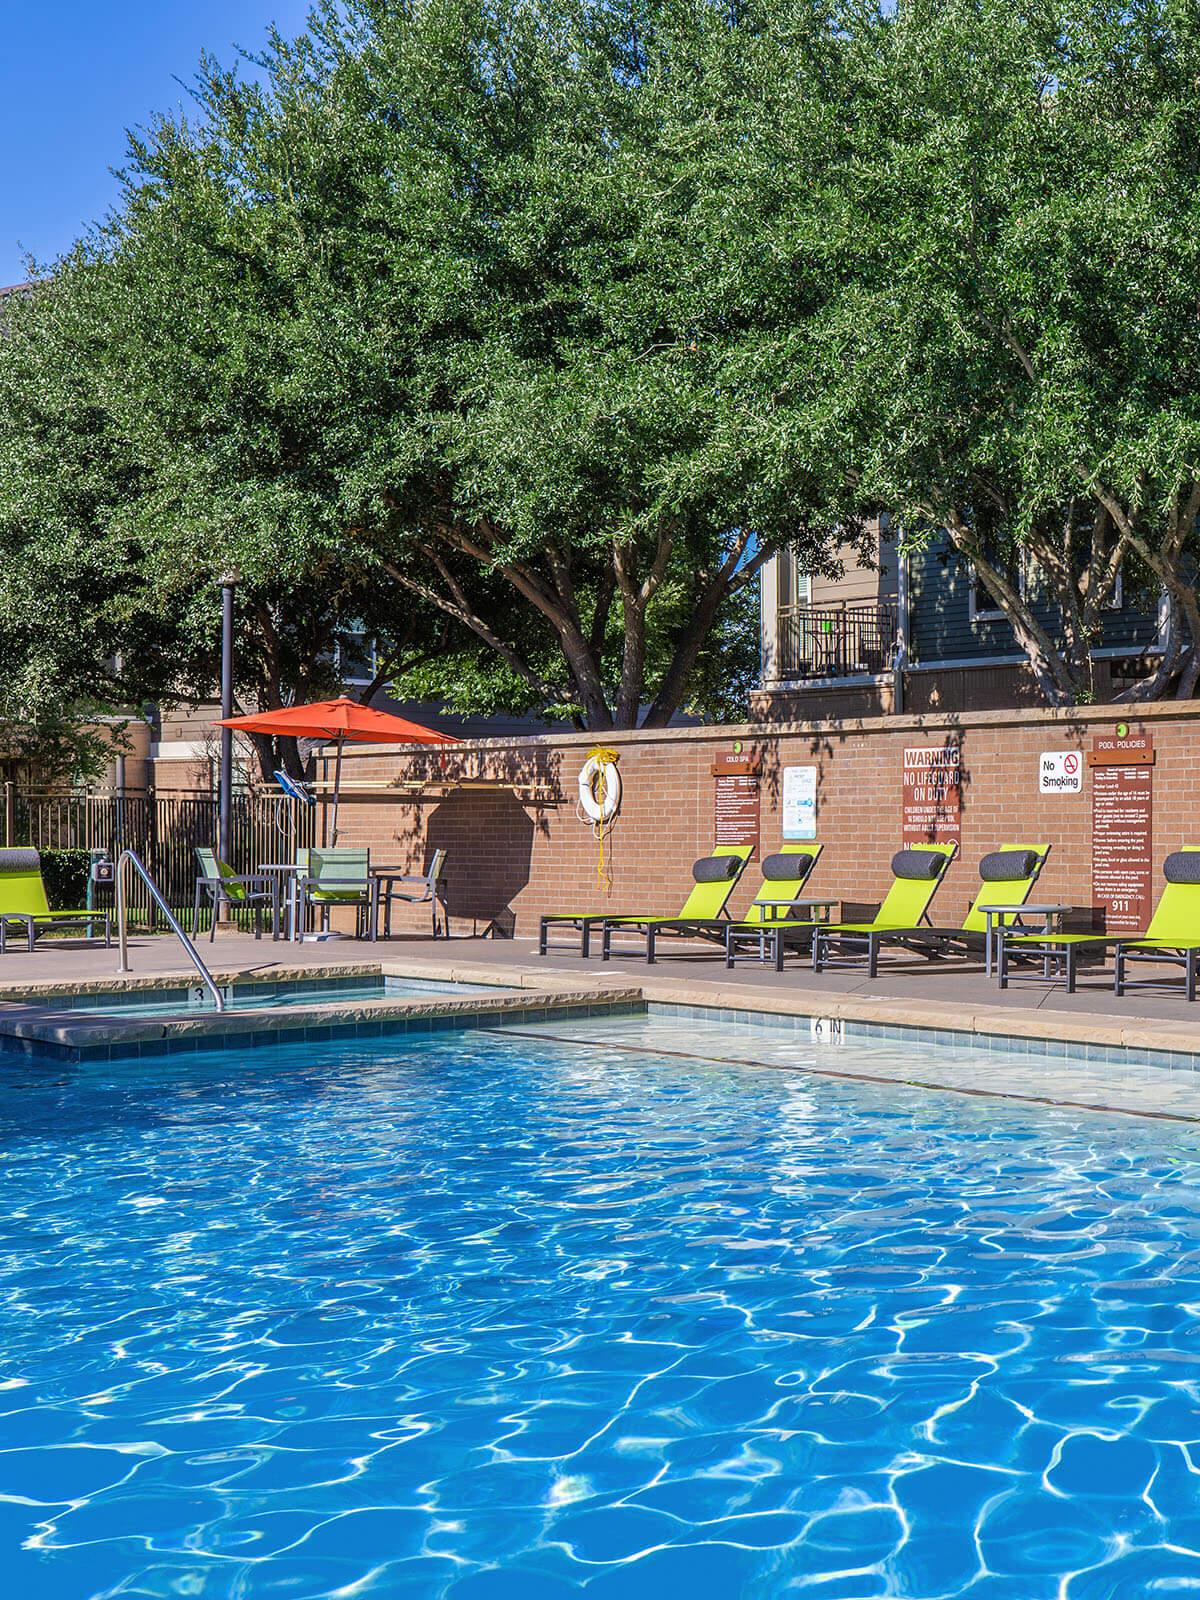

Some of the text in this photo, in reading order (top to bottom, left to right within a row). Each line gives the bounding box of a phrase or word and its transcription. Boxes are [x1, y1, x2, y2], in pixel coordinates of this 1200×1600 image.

[1098, 740, 1146, 749] POOL POLICIES
[906, 751, 959, 765] WARNING
[1043, 761, 1055, 771] No
[904, 771, 959, 785] NO LIFEGUARD
[1043, 775, 1079, 789] Smoking
[914, 787, 948, 801] ON DUTY
[1112, 900, 1129, 912] 911
[195, 987, 203, 1001] 3
[815, 1017, 841, 1035] 6 IN
